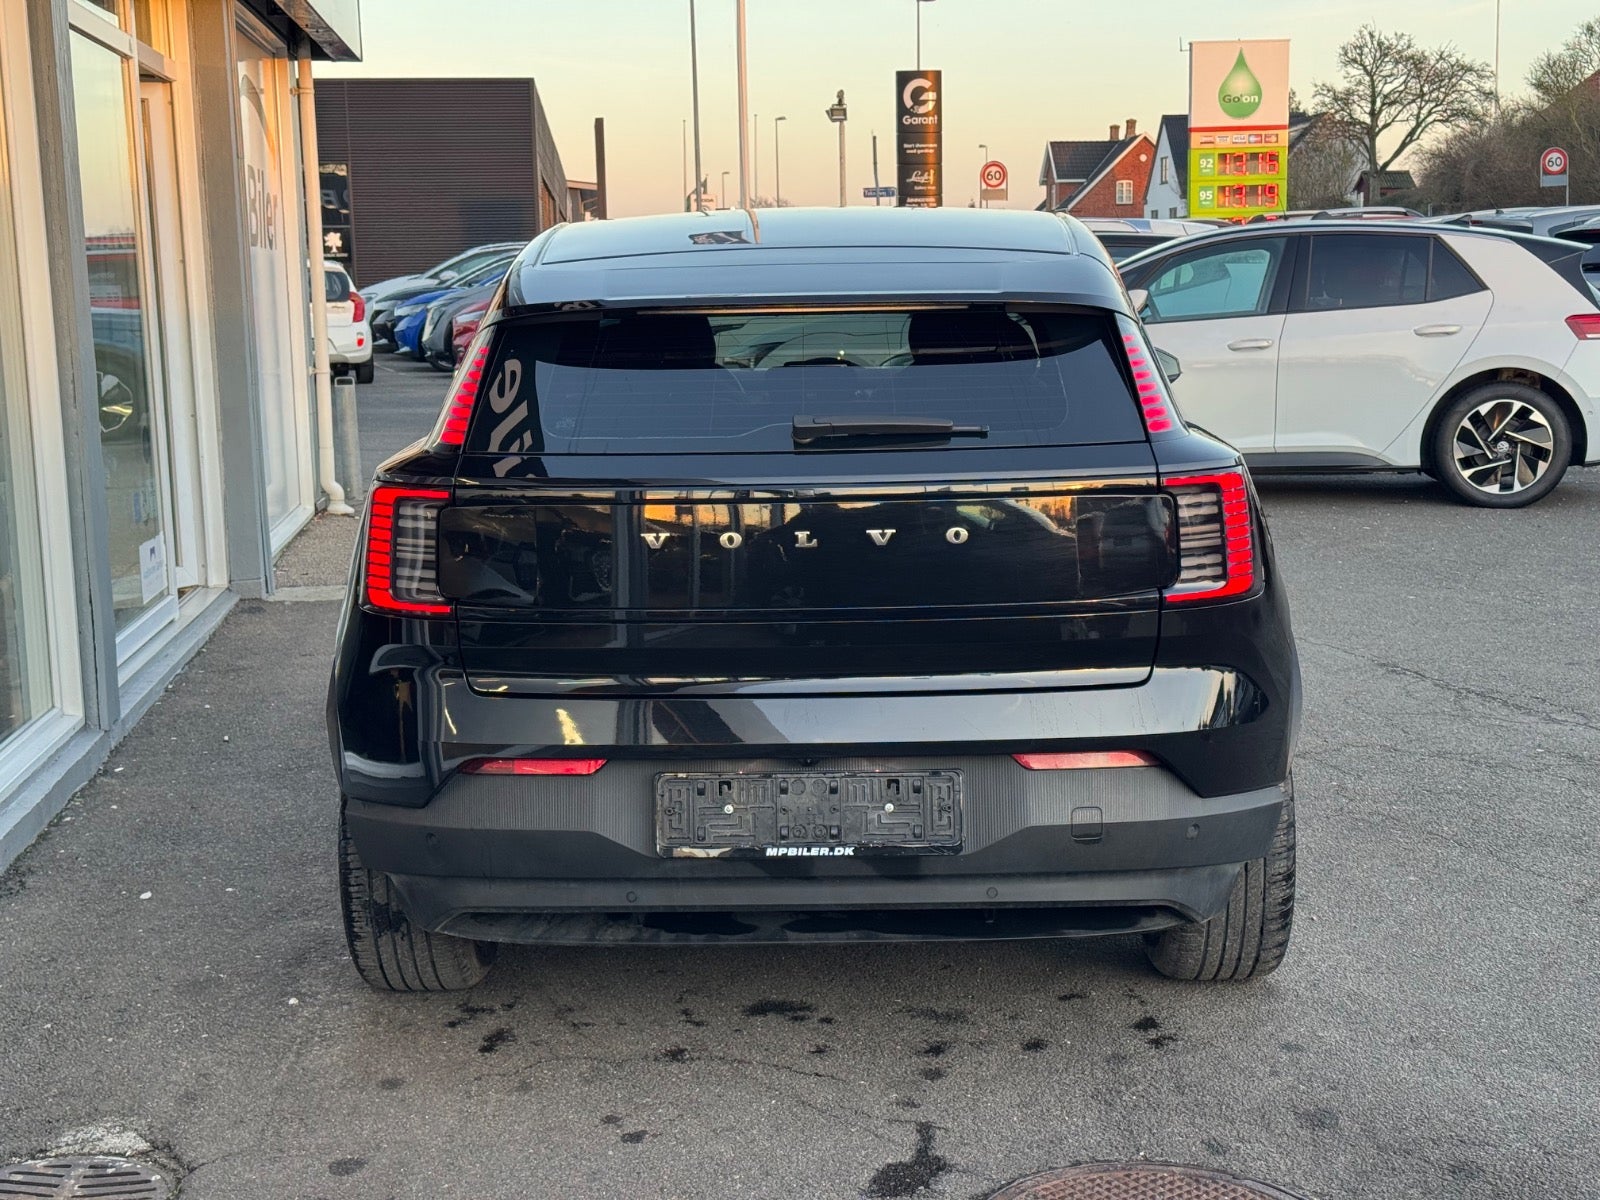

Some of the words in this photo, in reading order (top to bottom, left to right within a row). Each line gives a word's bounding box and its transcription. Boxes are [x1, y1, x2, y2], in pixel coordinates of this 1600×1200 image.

[1222, 94, 1259, 104] Go'on
[902, 115, 938, 125] Garant
[1199, 158, 1214, 169] 92
[1547, 156, 1563, 168] 60
[986, 170, 1002, 181] 60
[1199, 190, 1213, 200] 95
[247, 164, 279, 251] Biler
[640, 527, 970, 550] VOLVO
[765, 846, 856, 857] MPBILER.DK
